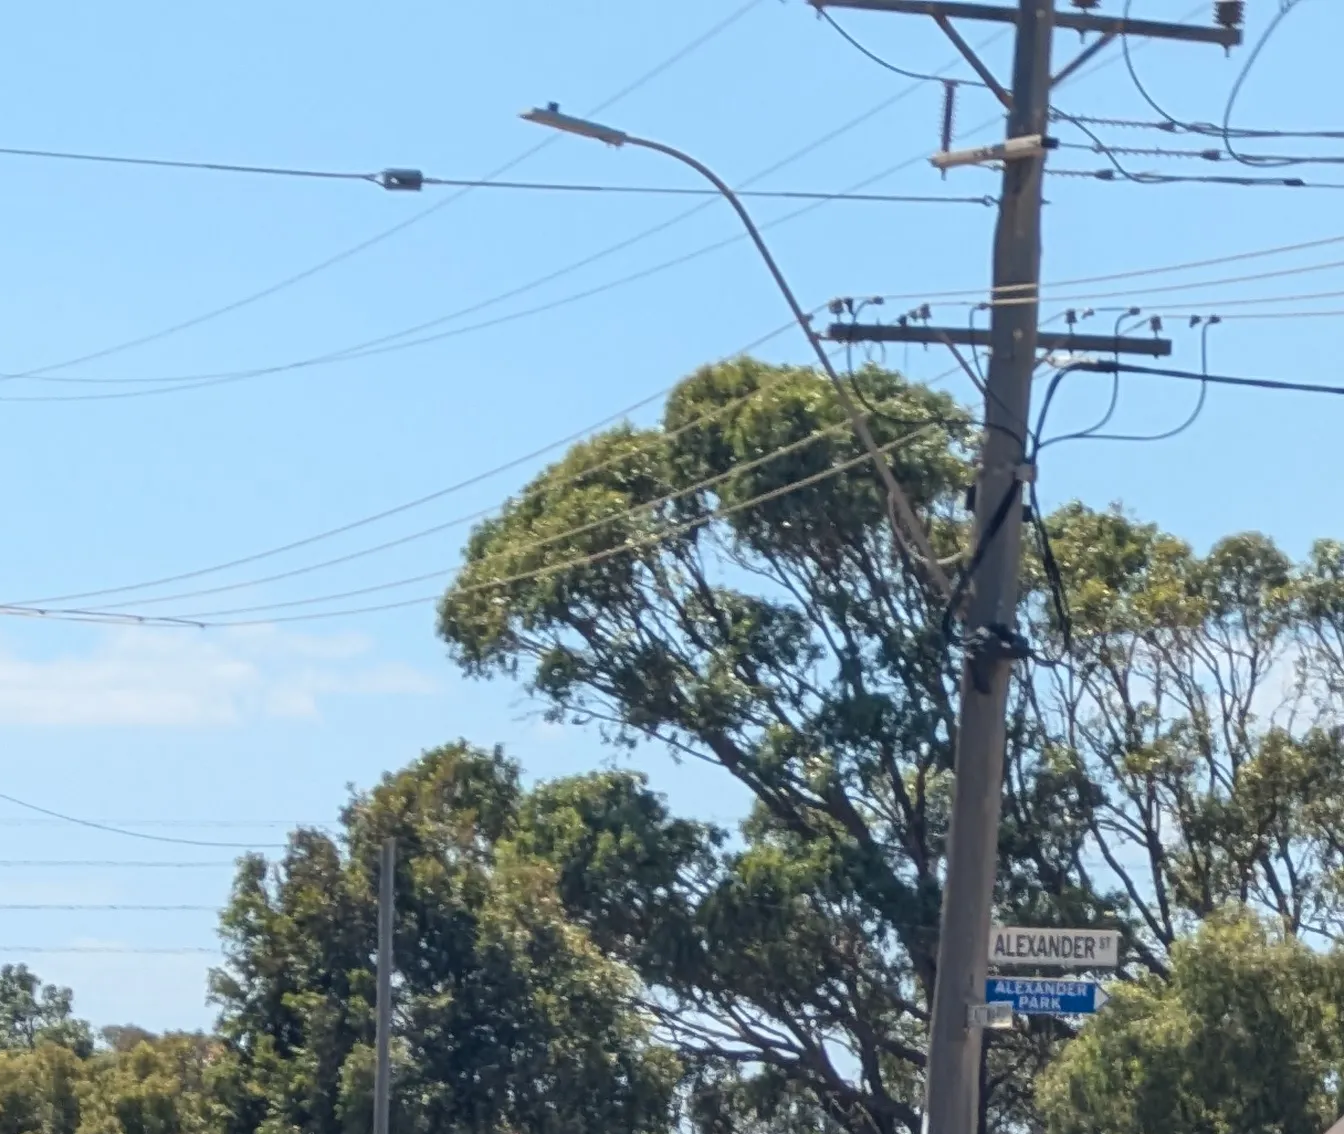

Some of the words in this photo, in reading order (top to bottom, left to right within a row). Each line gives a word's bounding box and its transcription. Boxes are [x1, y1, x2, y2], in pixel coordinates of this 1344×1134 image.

[994, 934, 1096, 959] ALEXANDER
[994, 981, 1089, 997] ALEXANDER
[1018, 996, 1062, 1009] PARK
